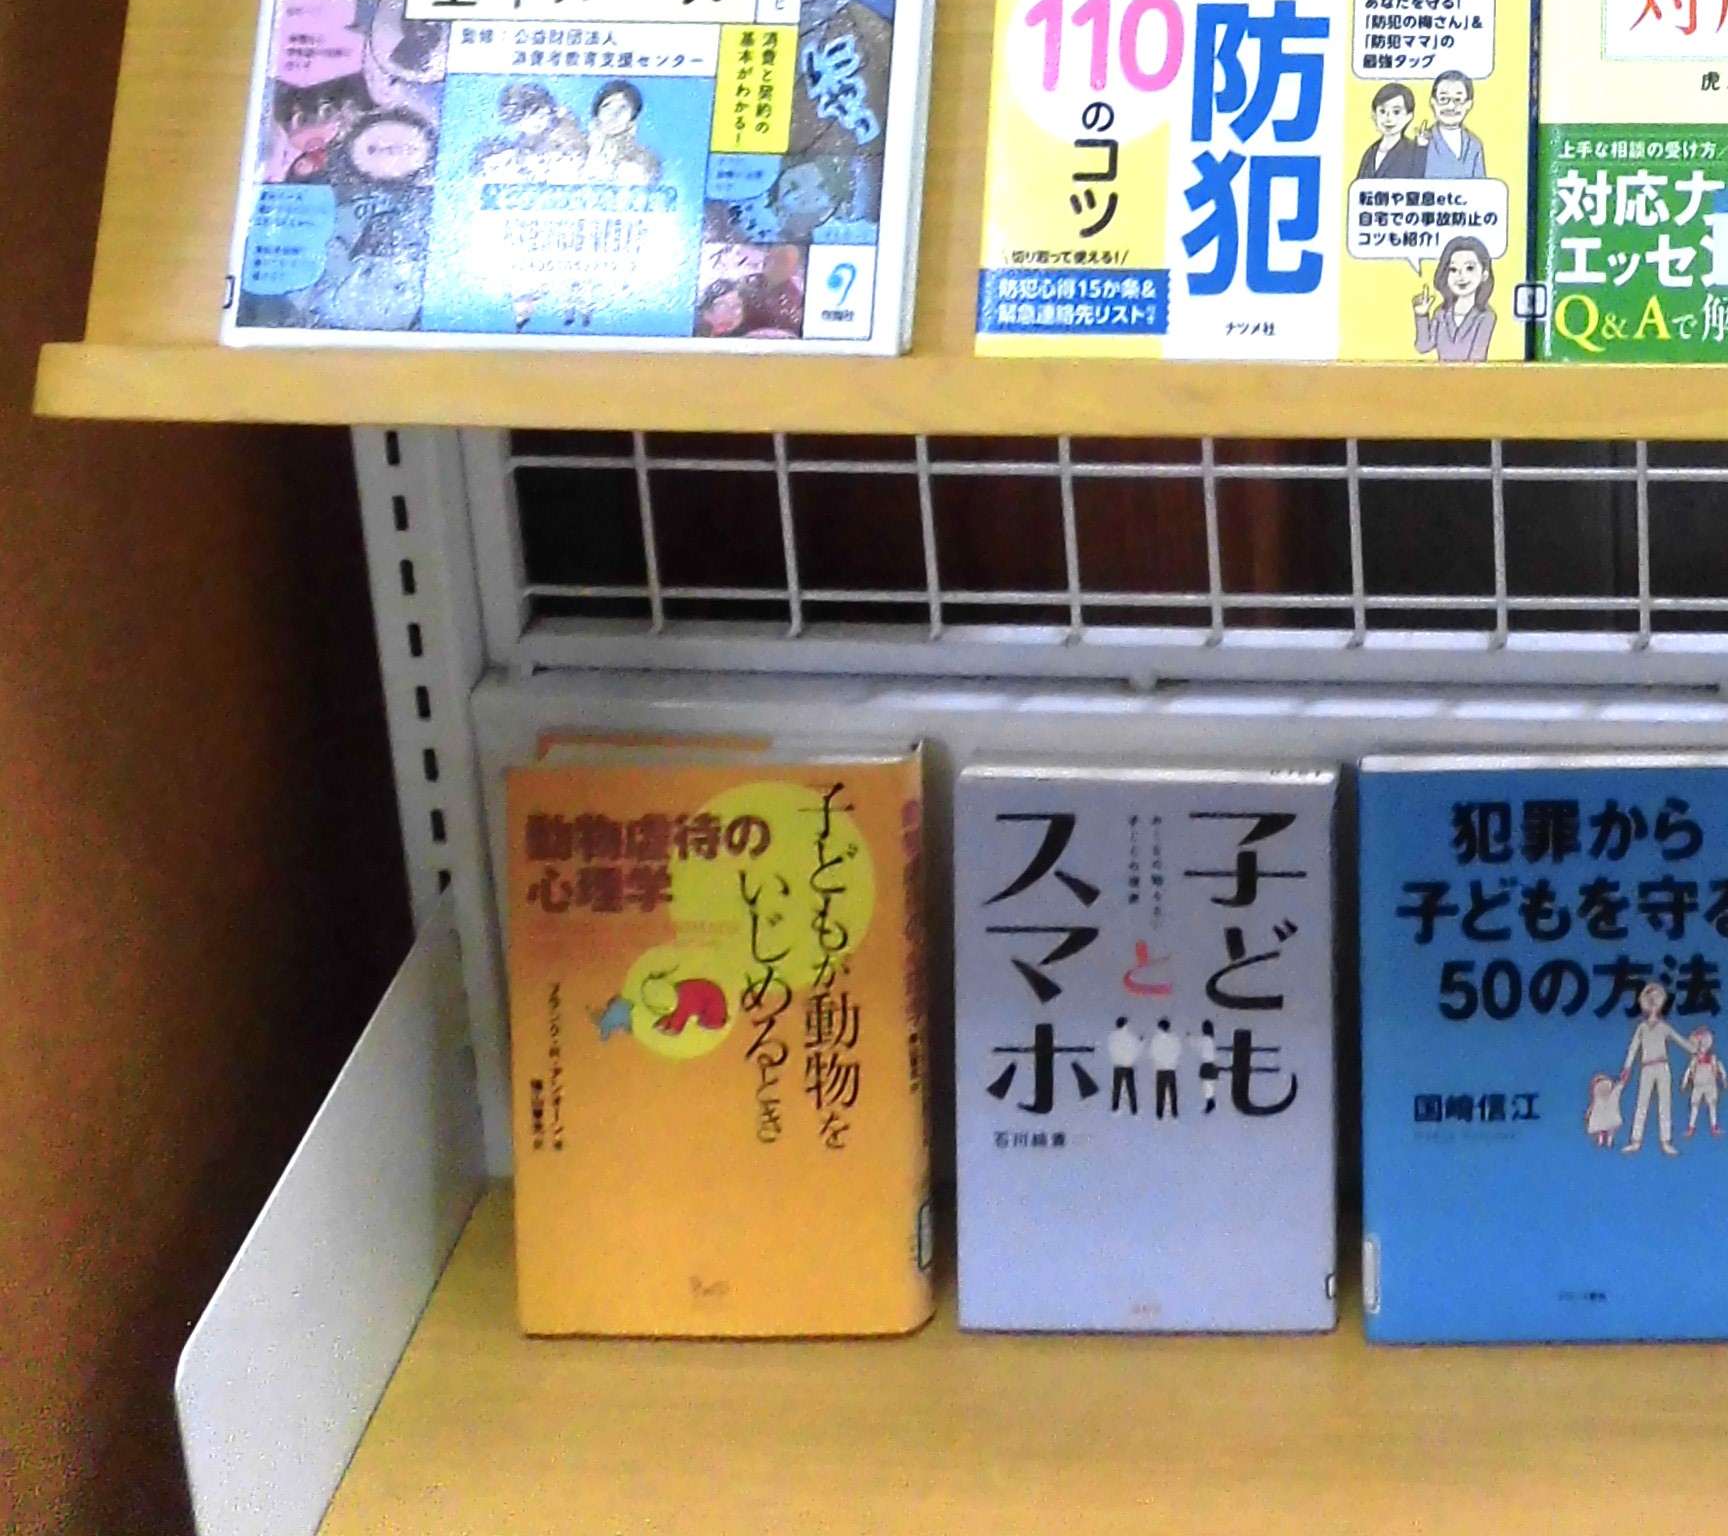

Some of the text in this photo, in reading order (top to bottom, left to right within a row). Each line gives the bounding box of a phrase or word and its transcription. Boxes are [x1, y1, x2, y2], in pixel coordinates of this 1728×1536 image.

[513, 29, 618, 46] 公益財団法人
[1363, 54, 1435, 70] 最強タッグ
[1364, 34, 1455, 50] 「防犯ママ」の
[1070, 101, 1119, 238] のコツ
[1358, 210, 1498, 227] 自宅での事故防止の
[1358, 231, 1440, 247] コツも紹介!
[525, 813, 772, 860] 動物虐待の
[1450, 797, 1704, 864] 犯罪から
[527, 869, 674, 915] 心理学
[797, 782, 863, 1151] 子どもが動物を
[982, 812, 1101, 1115] スマホ
[1122, 940, 1173, 996] と
[1183, 813, 1308, 1116] 子ども
[1438, 955, 1724, 1022] 50の方法
[738, 870, 794, 1145] いじめるとき
